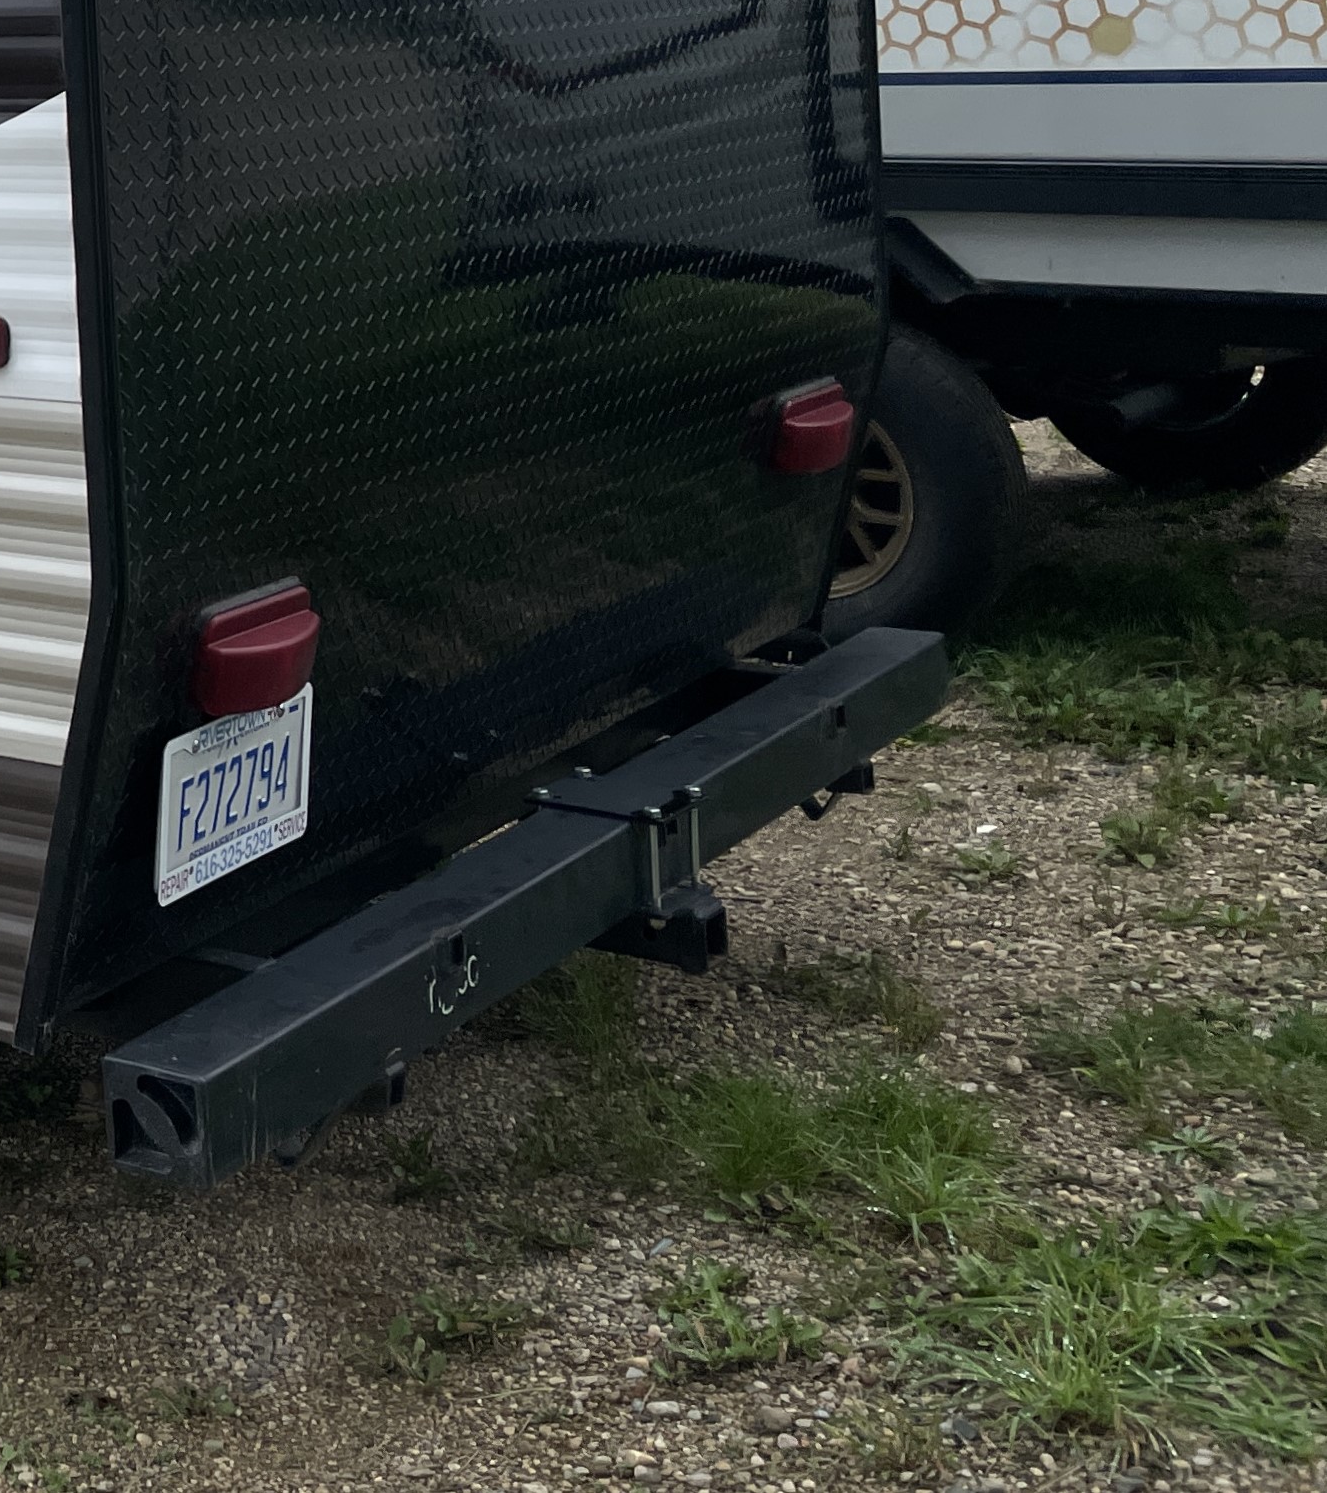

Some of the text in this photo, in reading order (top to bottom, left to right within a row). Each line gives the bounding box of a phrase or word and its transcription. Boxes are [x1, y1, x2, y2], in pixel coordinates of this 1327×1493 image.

[199, 709, 267, 748] RIVERTOWN
[176, 733, 290, 852] F272794
[160, 810, 307, 901] REPAIR 616-325-5291 SERVICE
